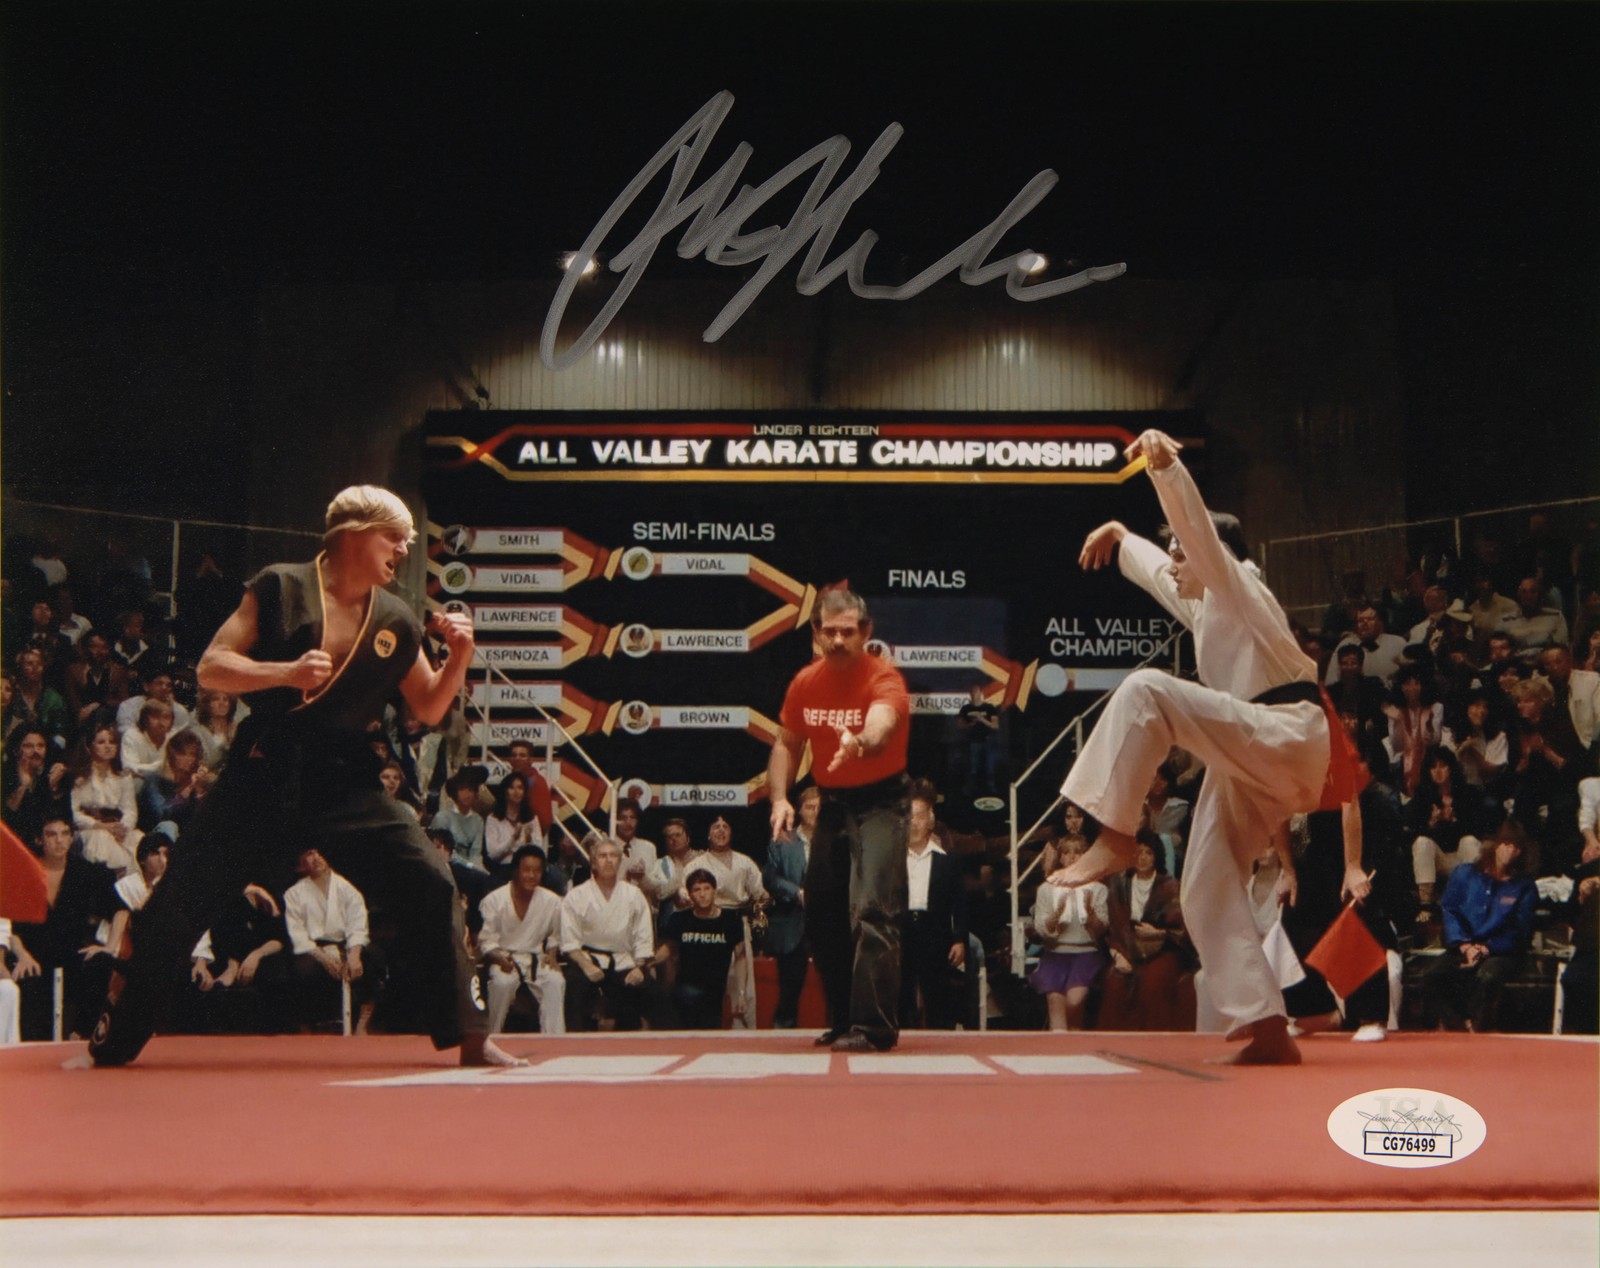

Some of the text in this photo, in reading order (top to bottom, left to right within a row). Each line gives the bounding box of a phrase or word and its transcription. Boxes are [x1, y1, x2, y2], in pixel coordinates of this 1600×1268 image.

[753, 424, 880, 436] UNDER EIGHTEEN
[517, 439, 1117, 467] ALL VALLEY KARATE CHAMPIONSHIP
[632, 522, 776, 542] SEMI-FINALS
[498, 534, 541, 546] SMITH
[685, 558, 726, 571] VIDAL
[500, 573, 541, 585] VIDAL
[887, 569, 967, 589] FINALS
[480, 610, 558, 623] LAWRENCE
[1045, 616, 1177, 636] ALL VALLEY
[666, 634, 743, 648] LAWRENCE
[1050, 638, 1171, 657] CHAMPION
[485, 649, 550, 661] ESPINOZA
[900, 650, 976, 662] LAWRENCE
[679, 711, 730, 724] BROWN
[803, 708, 862, 727] REFEREE
[670, 789, 736, 802] LARUSSO
[681, 932, 727, 944] OFFICIAL
